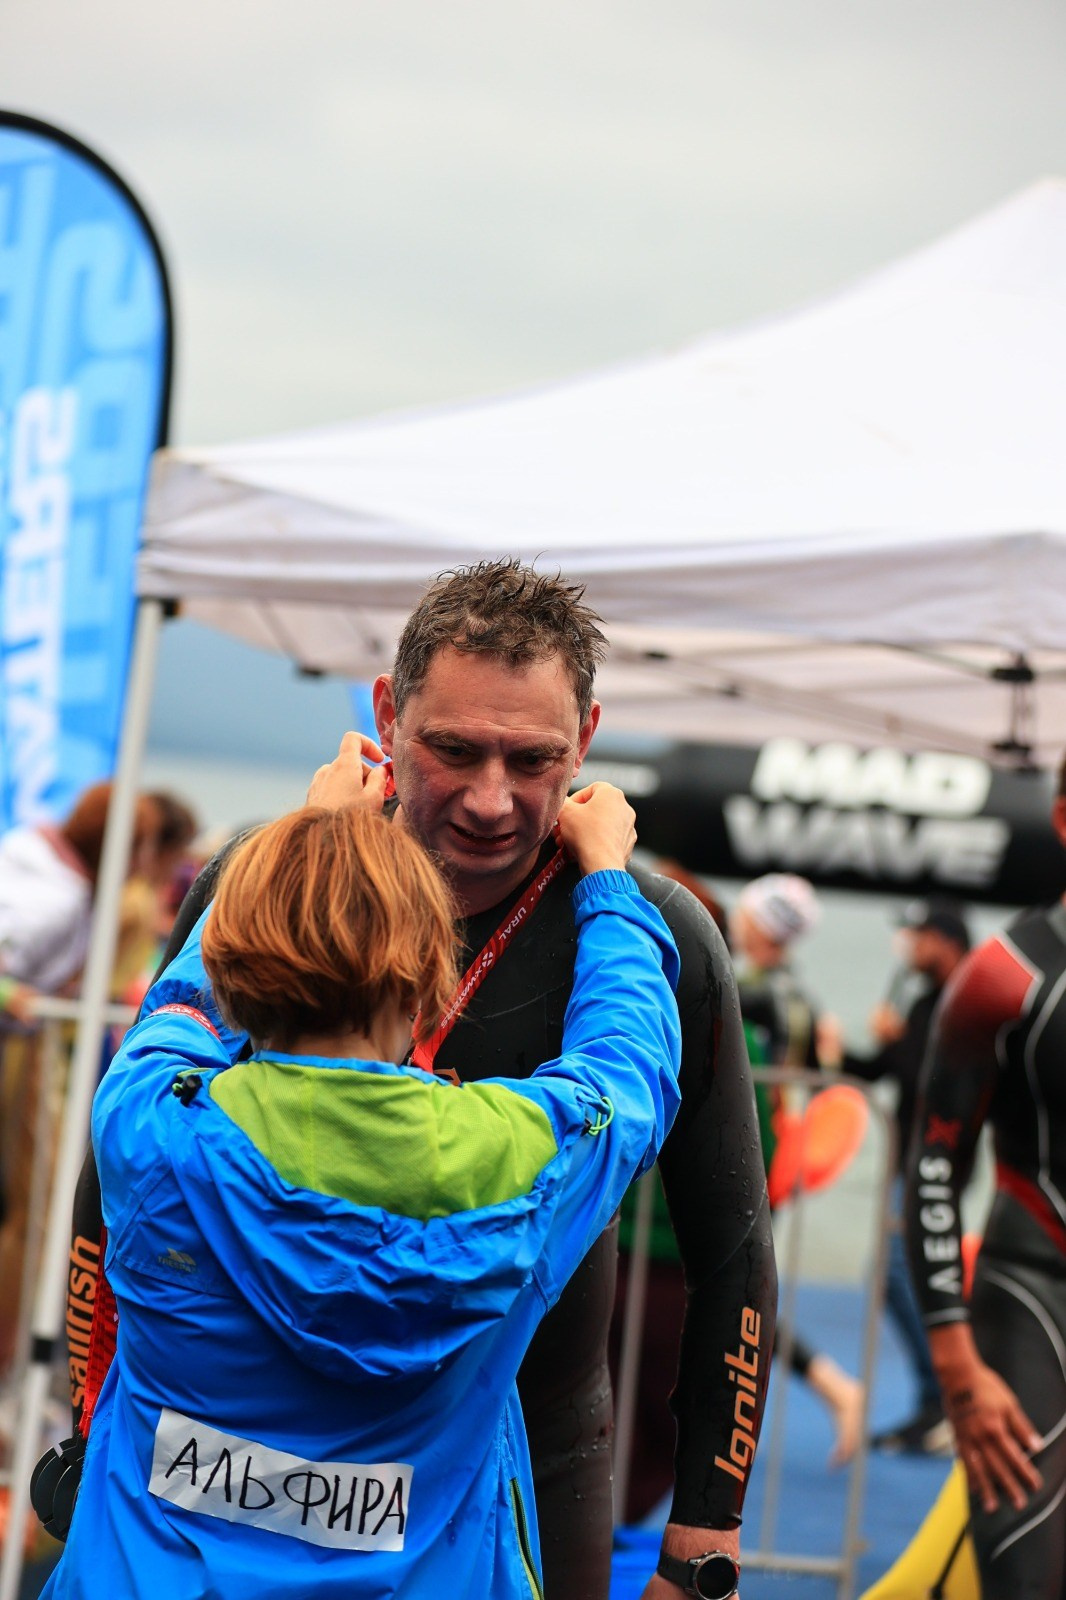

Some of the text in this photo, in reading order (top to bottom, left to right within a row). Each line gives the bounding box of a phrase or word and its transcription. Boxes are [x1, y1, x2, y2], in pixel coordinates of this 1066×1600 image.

[750, 736, 992, 820] MAD
[537, 873, 554, 892] KM
[723, 797, 1011, 891] WAVE
[498, 906, 527, 940] URAL
[918, 1156, 963, 1295] AEGIS
[65, 1235, 101, 1408] sailfish
[714, 1306, 761, 1482] Ignite
[165, 1437, 404, 1536] АЛЬФИРА
